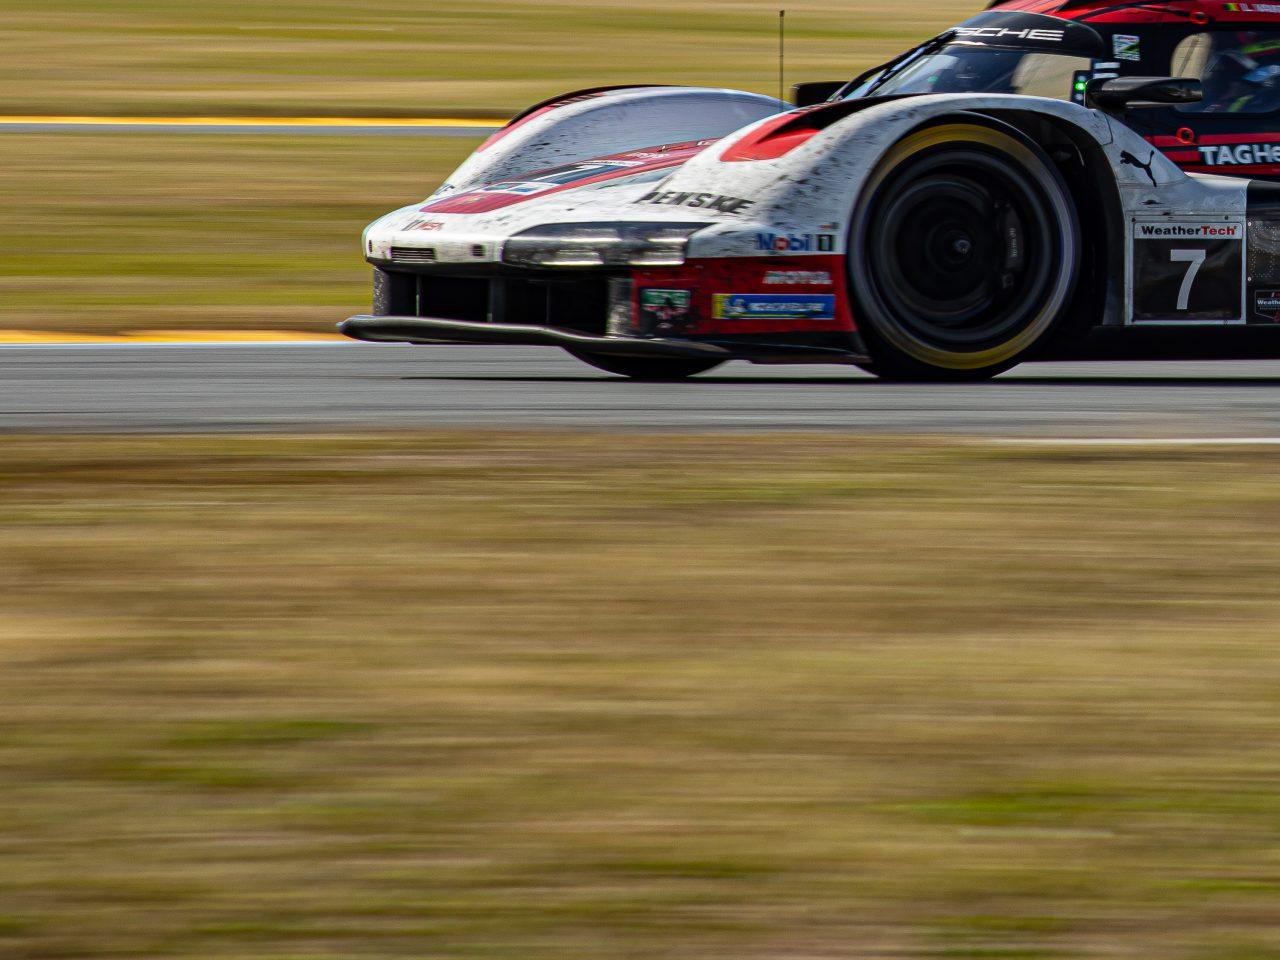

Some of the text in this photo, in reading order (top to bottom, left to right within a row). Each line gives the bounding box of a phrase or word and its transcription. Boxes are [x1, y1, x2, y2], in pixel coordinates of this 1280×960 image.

[950, 27, 1065, 41] SCHE
[1141, 225, 1236, 236] WeatherTech
[756, 233, 813, 251] Mobil
[1170, 249, 1206, 310] 7
